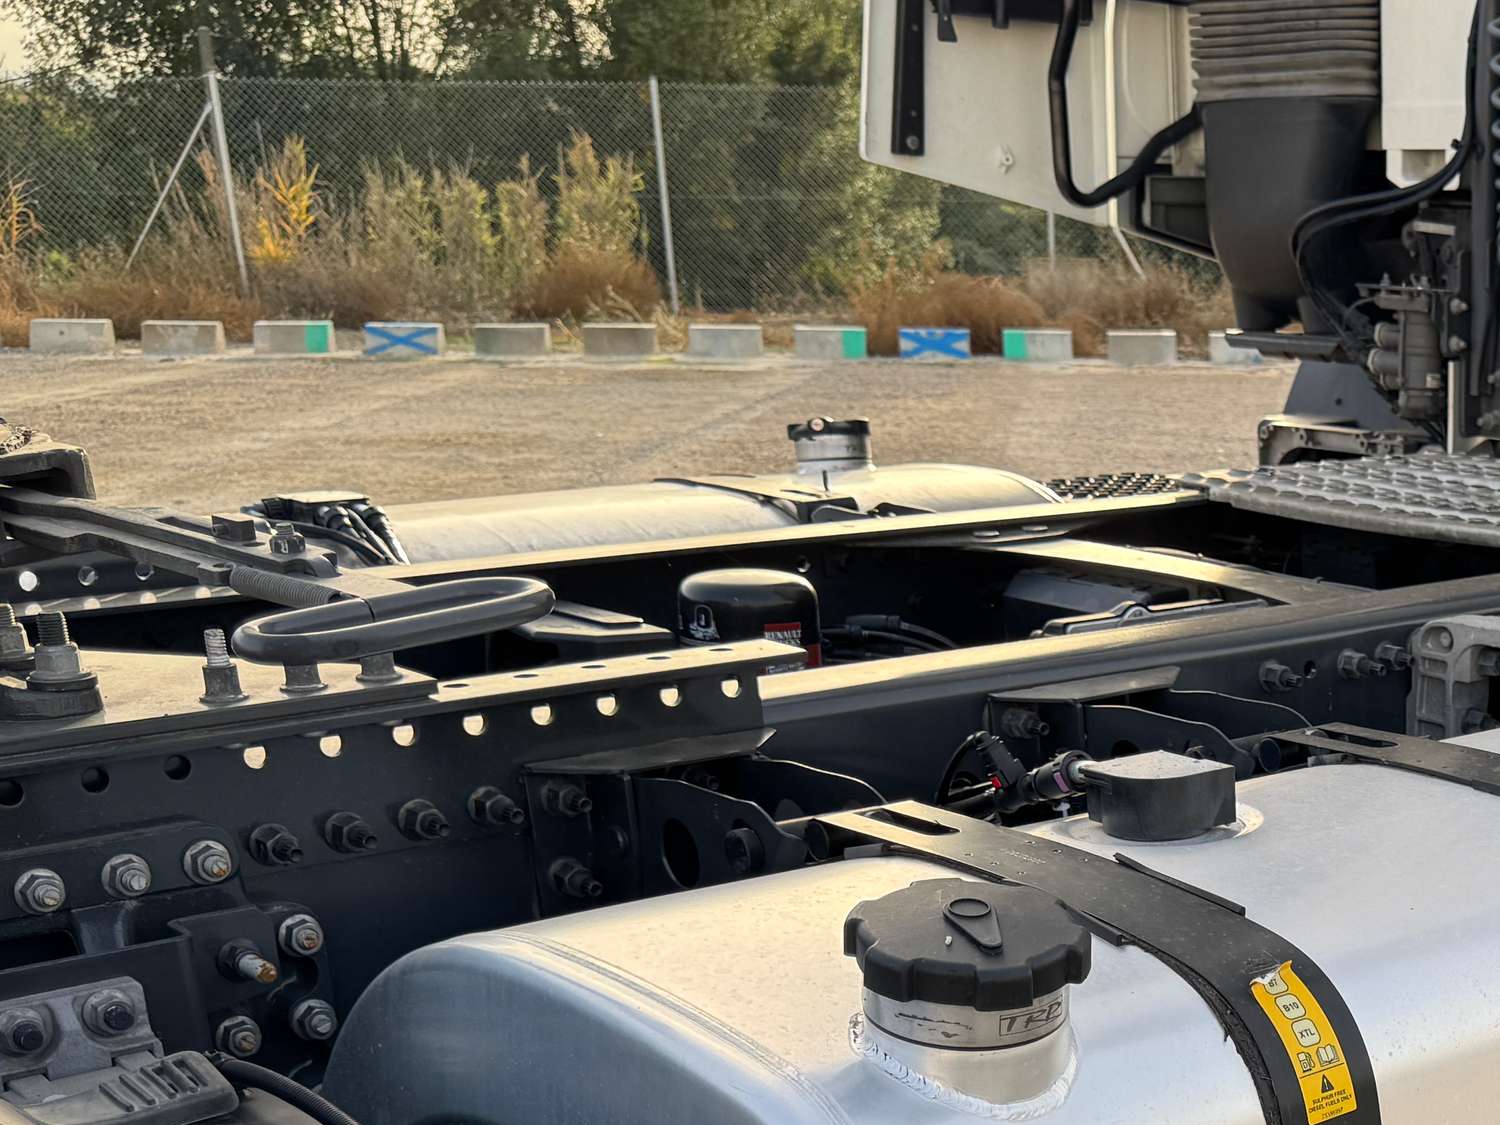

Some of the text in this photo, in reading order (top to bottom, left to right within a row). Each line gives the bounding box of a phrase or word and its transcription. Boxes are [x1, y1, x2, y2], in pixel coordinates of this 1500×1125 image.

[1282, 1001, 1299, 1012] B10
[1299, 1028, 1315, 1039] XTL
[1334, 1089, 1346, 1098] FREE
[1340, 1094, 1352, 1102] ONLY
